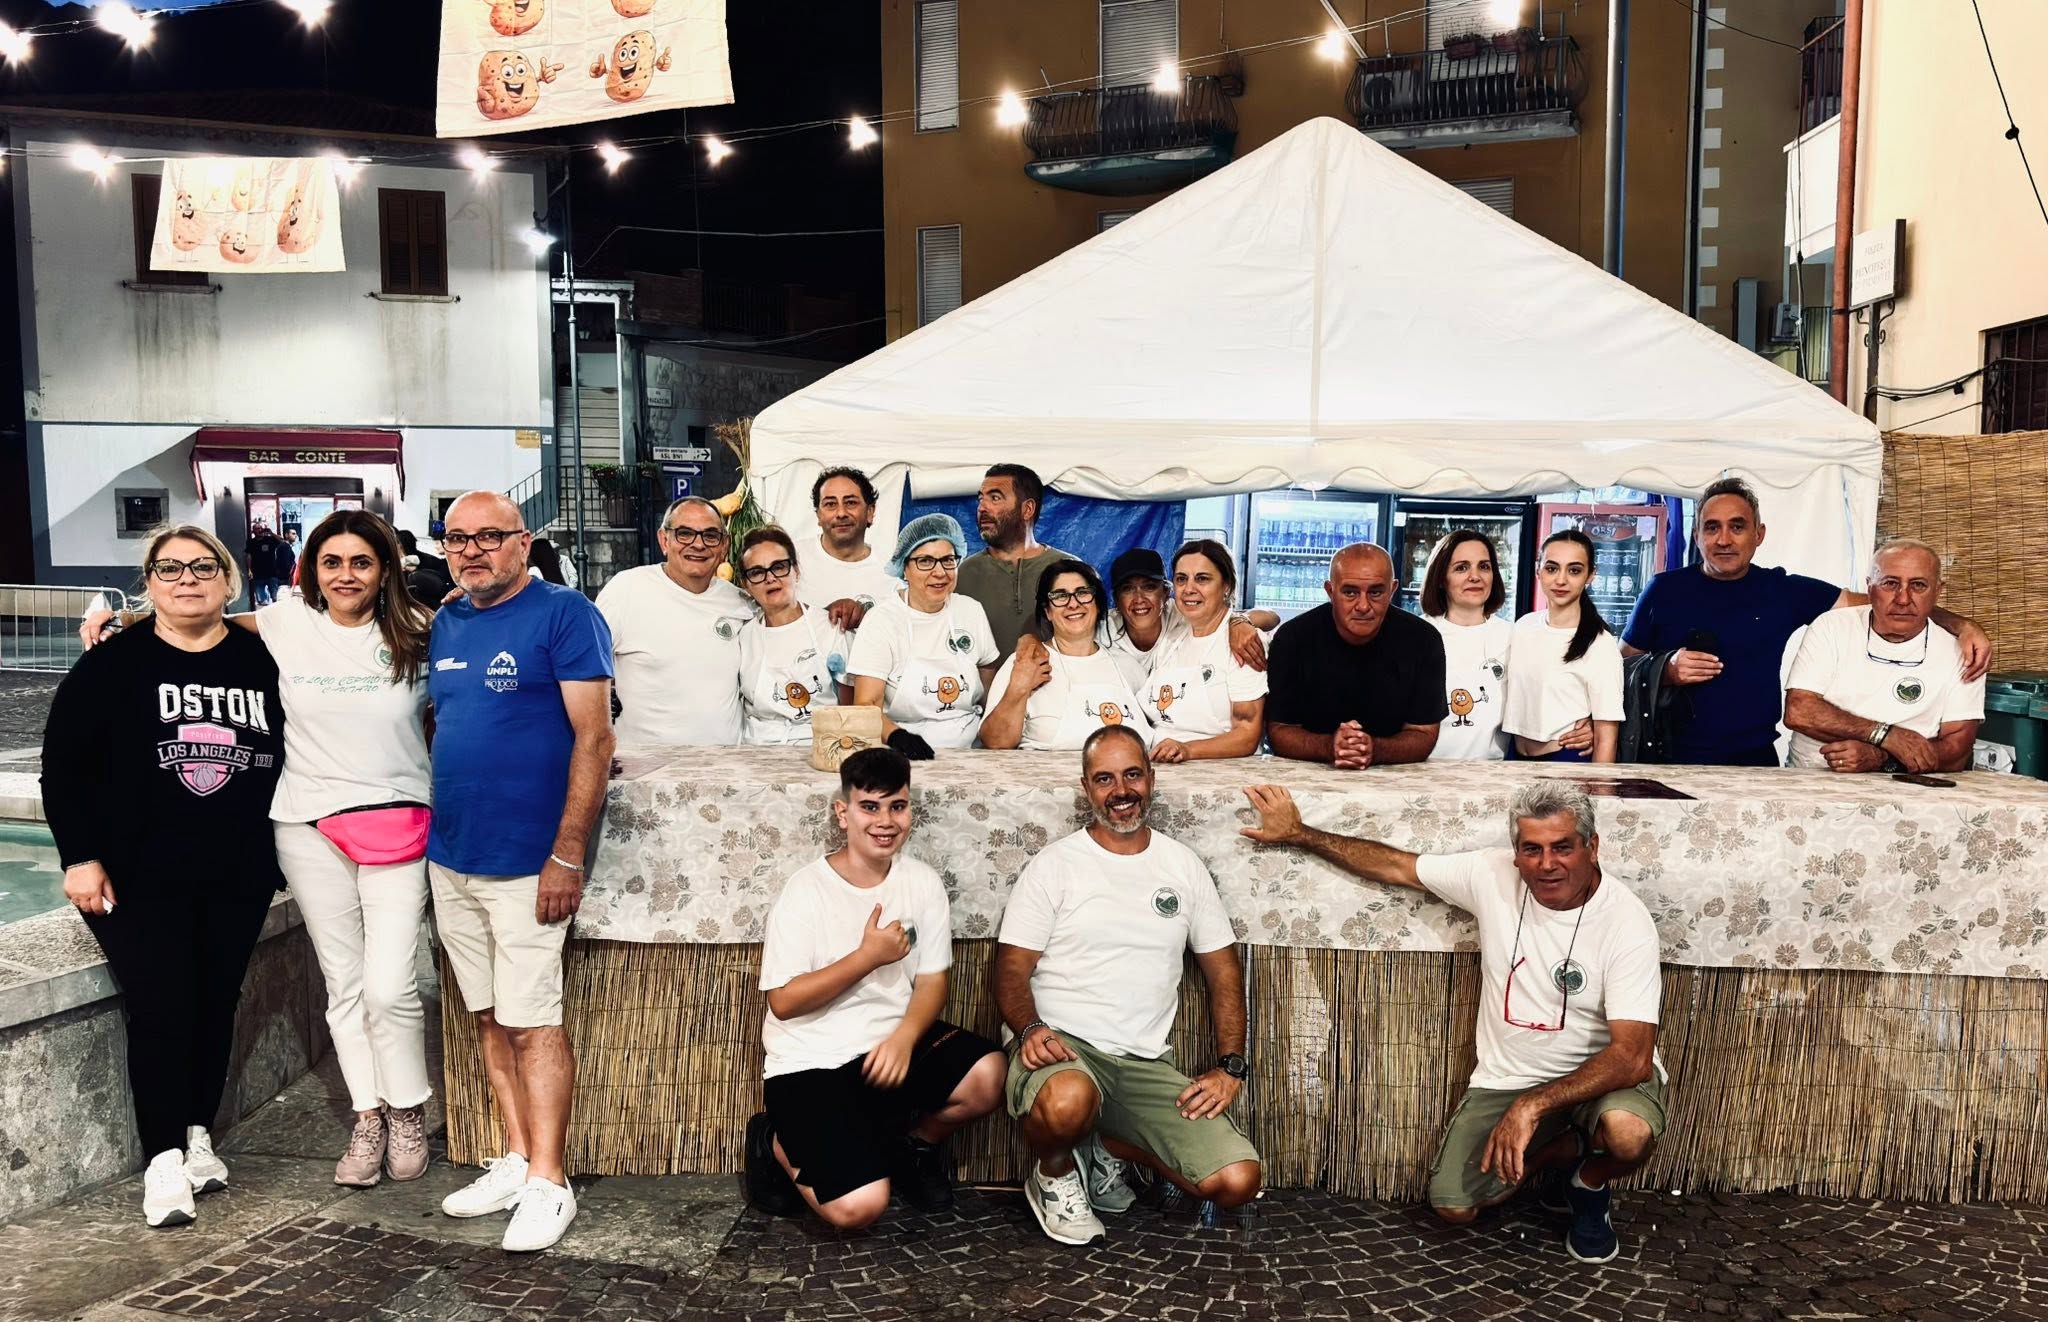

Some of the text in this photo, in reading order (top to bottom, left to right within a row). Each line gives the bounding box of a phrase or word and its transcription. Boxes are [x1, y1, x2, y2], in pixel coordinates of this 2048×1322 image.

[248, 451, 346, 463] BAR CONTE
[677, 479, 688, 495] P
[487, 667, 518, 675] UNPLI
[158, 683, 271, 735] OSTON
[157, 744, 251, 764] LOS ANGELES
